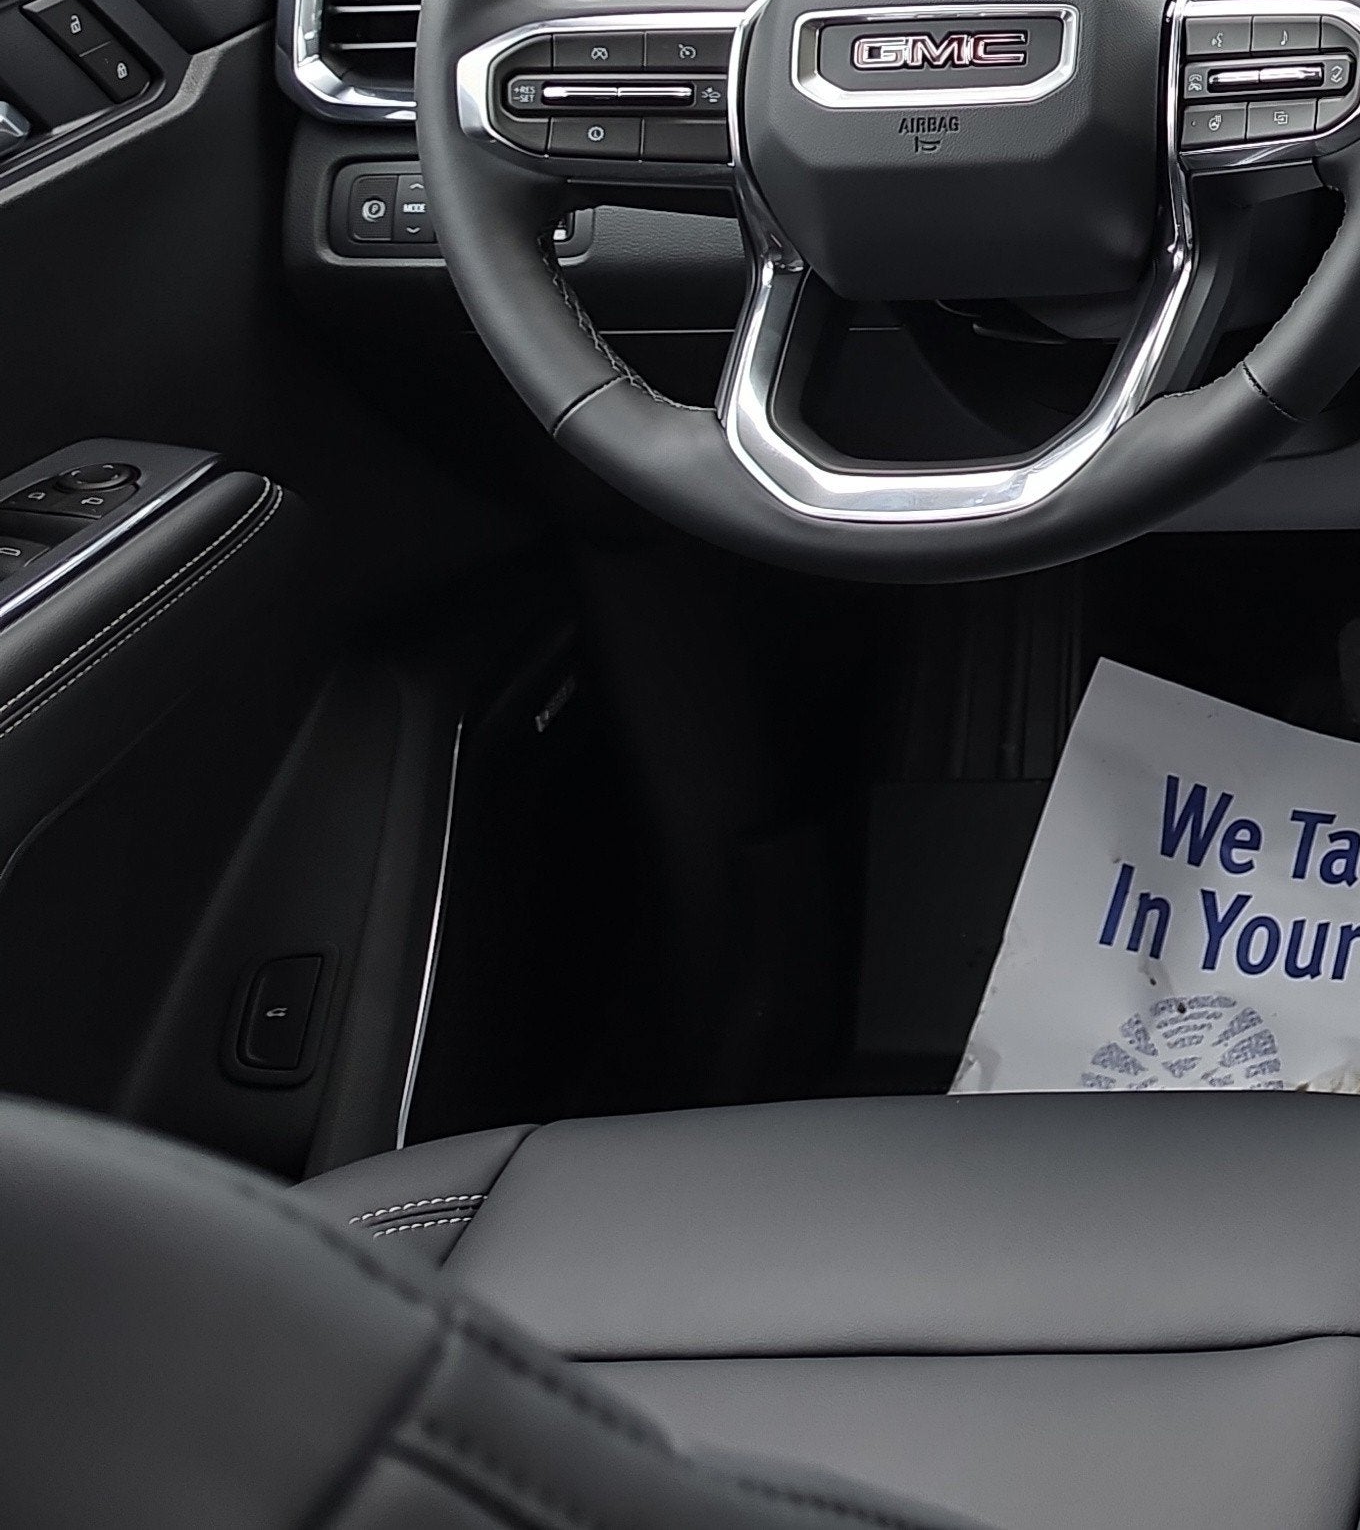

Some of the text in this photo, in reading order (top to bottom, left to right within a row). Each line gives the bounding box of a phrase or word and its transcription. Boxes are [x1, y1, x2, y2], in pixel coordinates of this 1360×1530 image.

[853, 33, 1026, 69] GMC
[898, 117, 960, 134] AIRBAG
[403, 203, 426, 213] MODE
[1158, 773, 1263, 874] We
[1098, 862, 1173, 960] In
